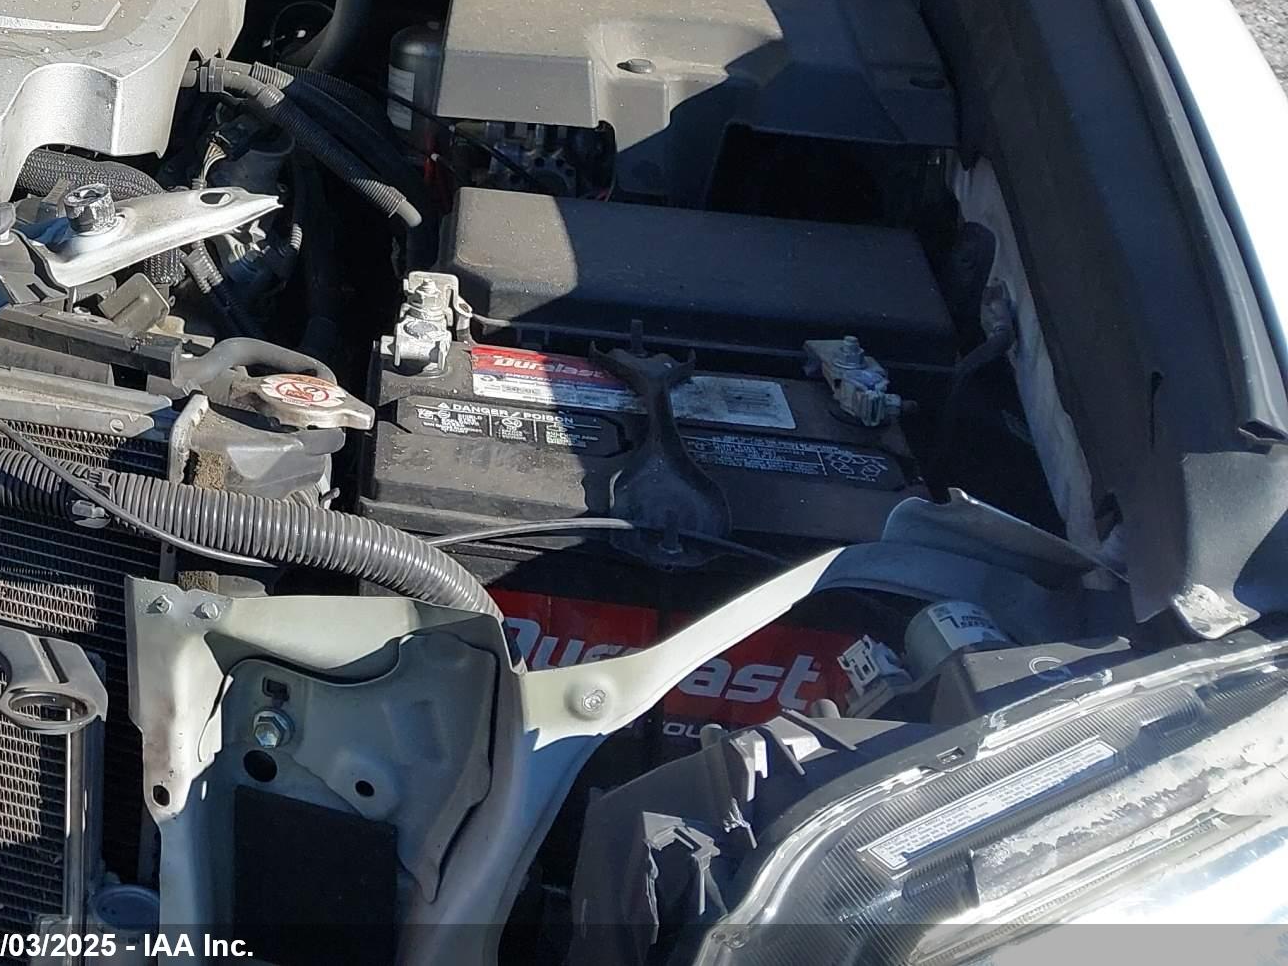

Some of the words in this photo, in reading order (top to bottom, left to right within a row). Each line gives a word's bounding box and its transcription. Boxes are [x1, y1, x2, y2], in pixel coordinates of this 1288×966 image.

[493, 355, 607, 378] Duralast
[452, 403, 509, 417] DANGER
[523, 412, 575, 425] POISON
